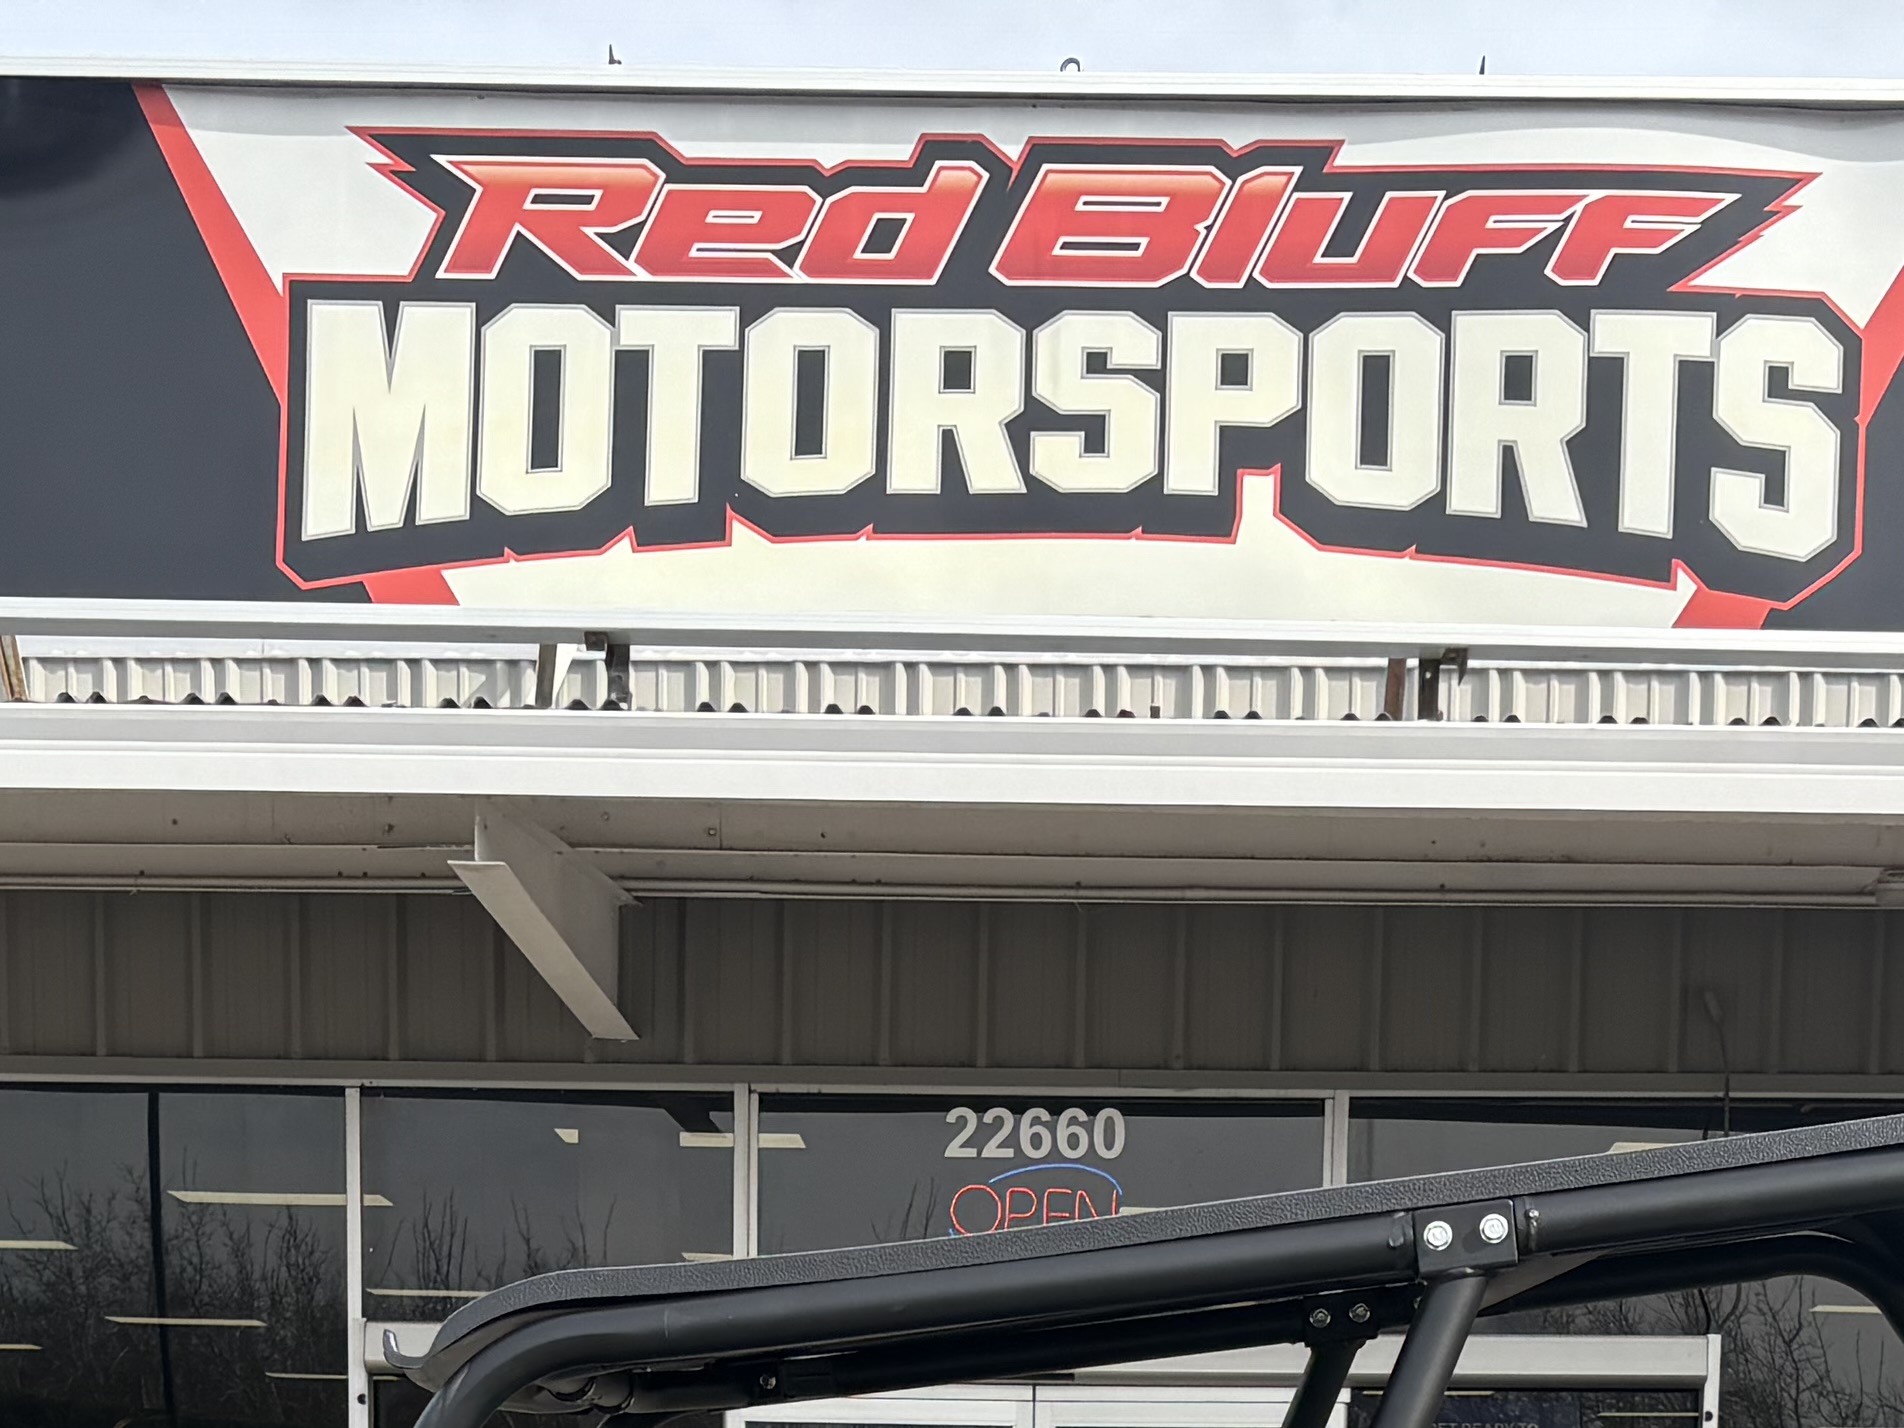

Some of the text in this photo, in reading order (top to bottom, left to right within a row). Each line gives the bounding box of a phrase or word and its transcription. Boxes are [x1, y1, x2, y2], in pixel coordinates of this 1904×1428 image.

[430, 155, 989, 286] Red
[300, 299, 1845, 563] MOTORSPORTS
[944, 1106, 1126, 1160] 22660
[949, 1184, 1120, 1236] OPEN
